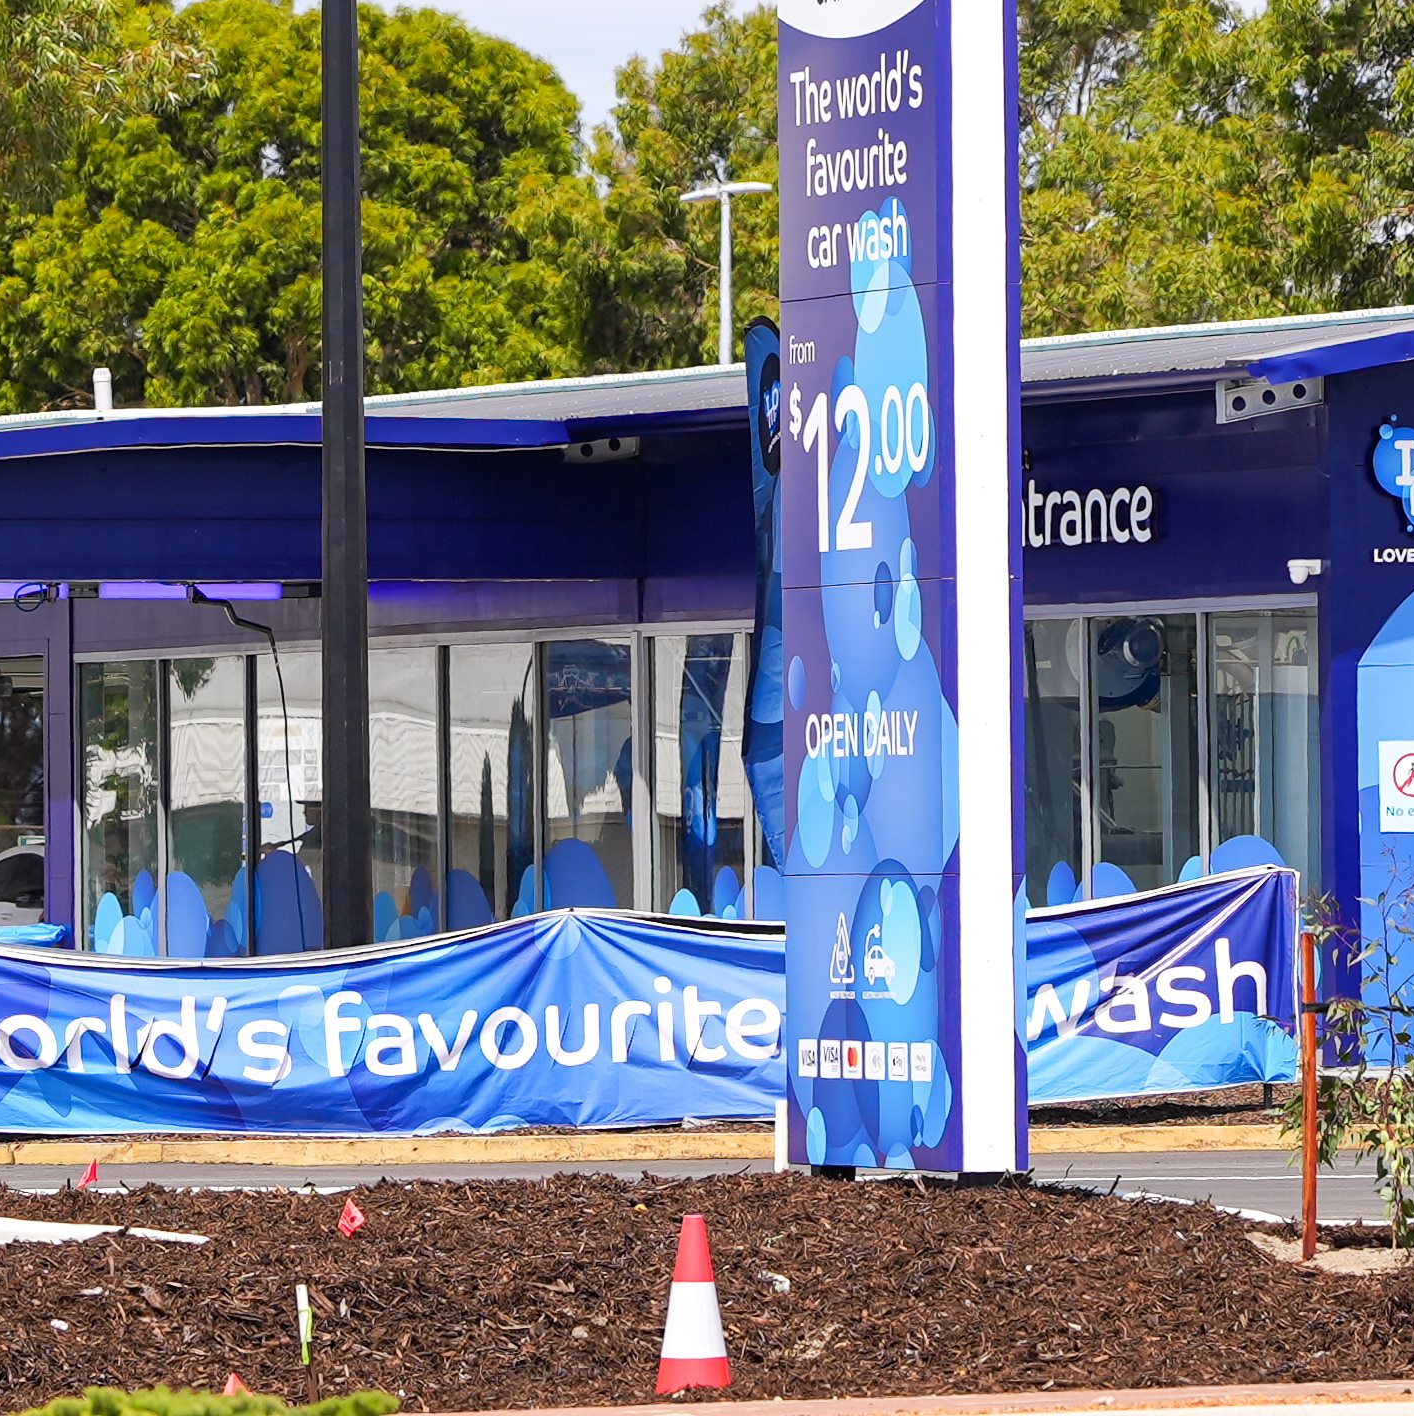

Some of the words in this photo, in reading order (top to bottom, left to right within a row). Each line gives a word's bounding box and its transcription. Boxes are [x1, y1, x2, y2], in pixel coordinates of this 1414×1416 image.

[790, 66, 832, 127] The
[837, 49, 924, 120] world's
[806, 128, 908, 197] favourite
[807, 222, 842, 270] car
[847, 198, 908, 263] wash
[789, 334, 816, 365] from
[789, 381, 930, 553] $12.00
[1021, 479, 1153, 547] trance
[805, 712, 859, 760] OPEN
[863, 709, 919, 757] DAILY
[1386, 806, 1404, 817] No
[322, 975, 782, 1078] favourite
[1026, 937, 1268, 1042] wash
[801, 1049, 817, 1067] VISA
[822, 1045, 840, 1064] VISA
